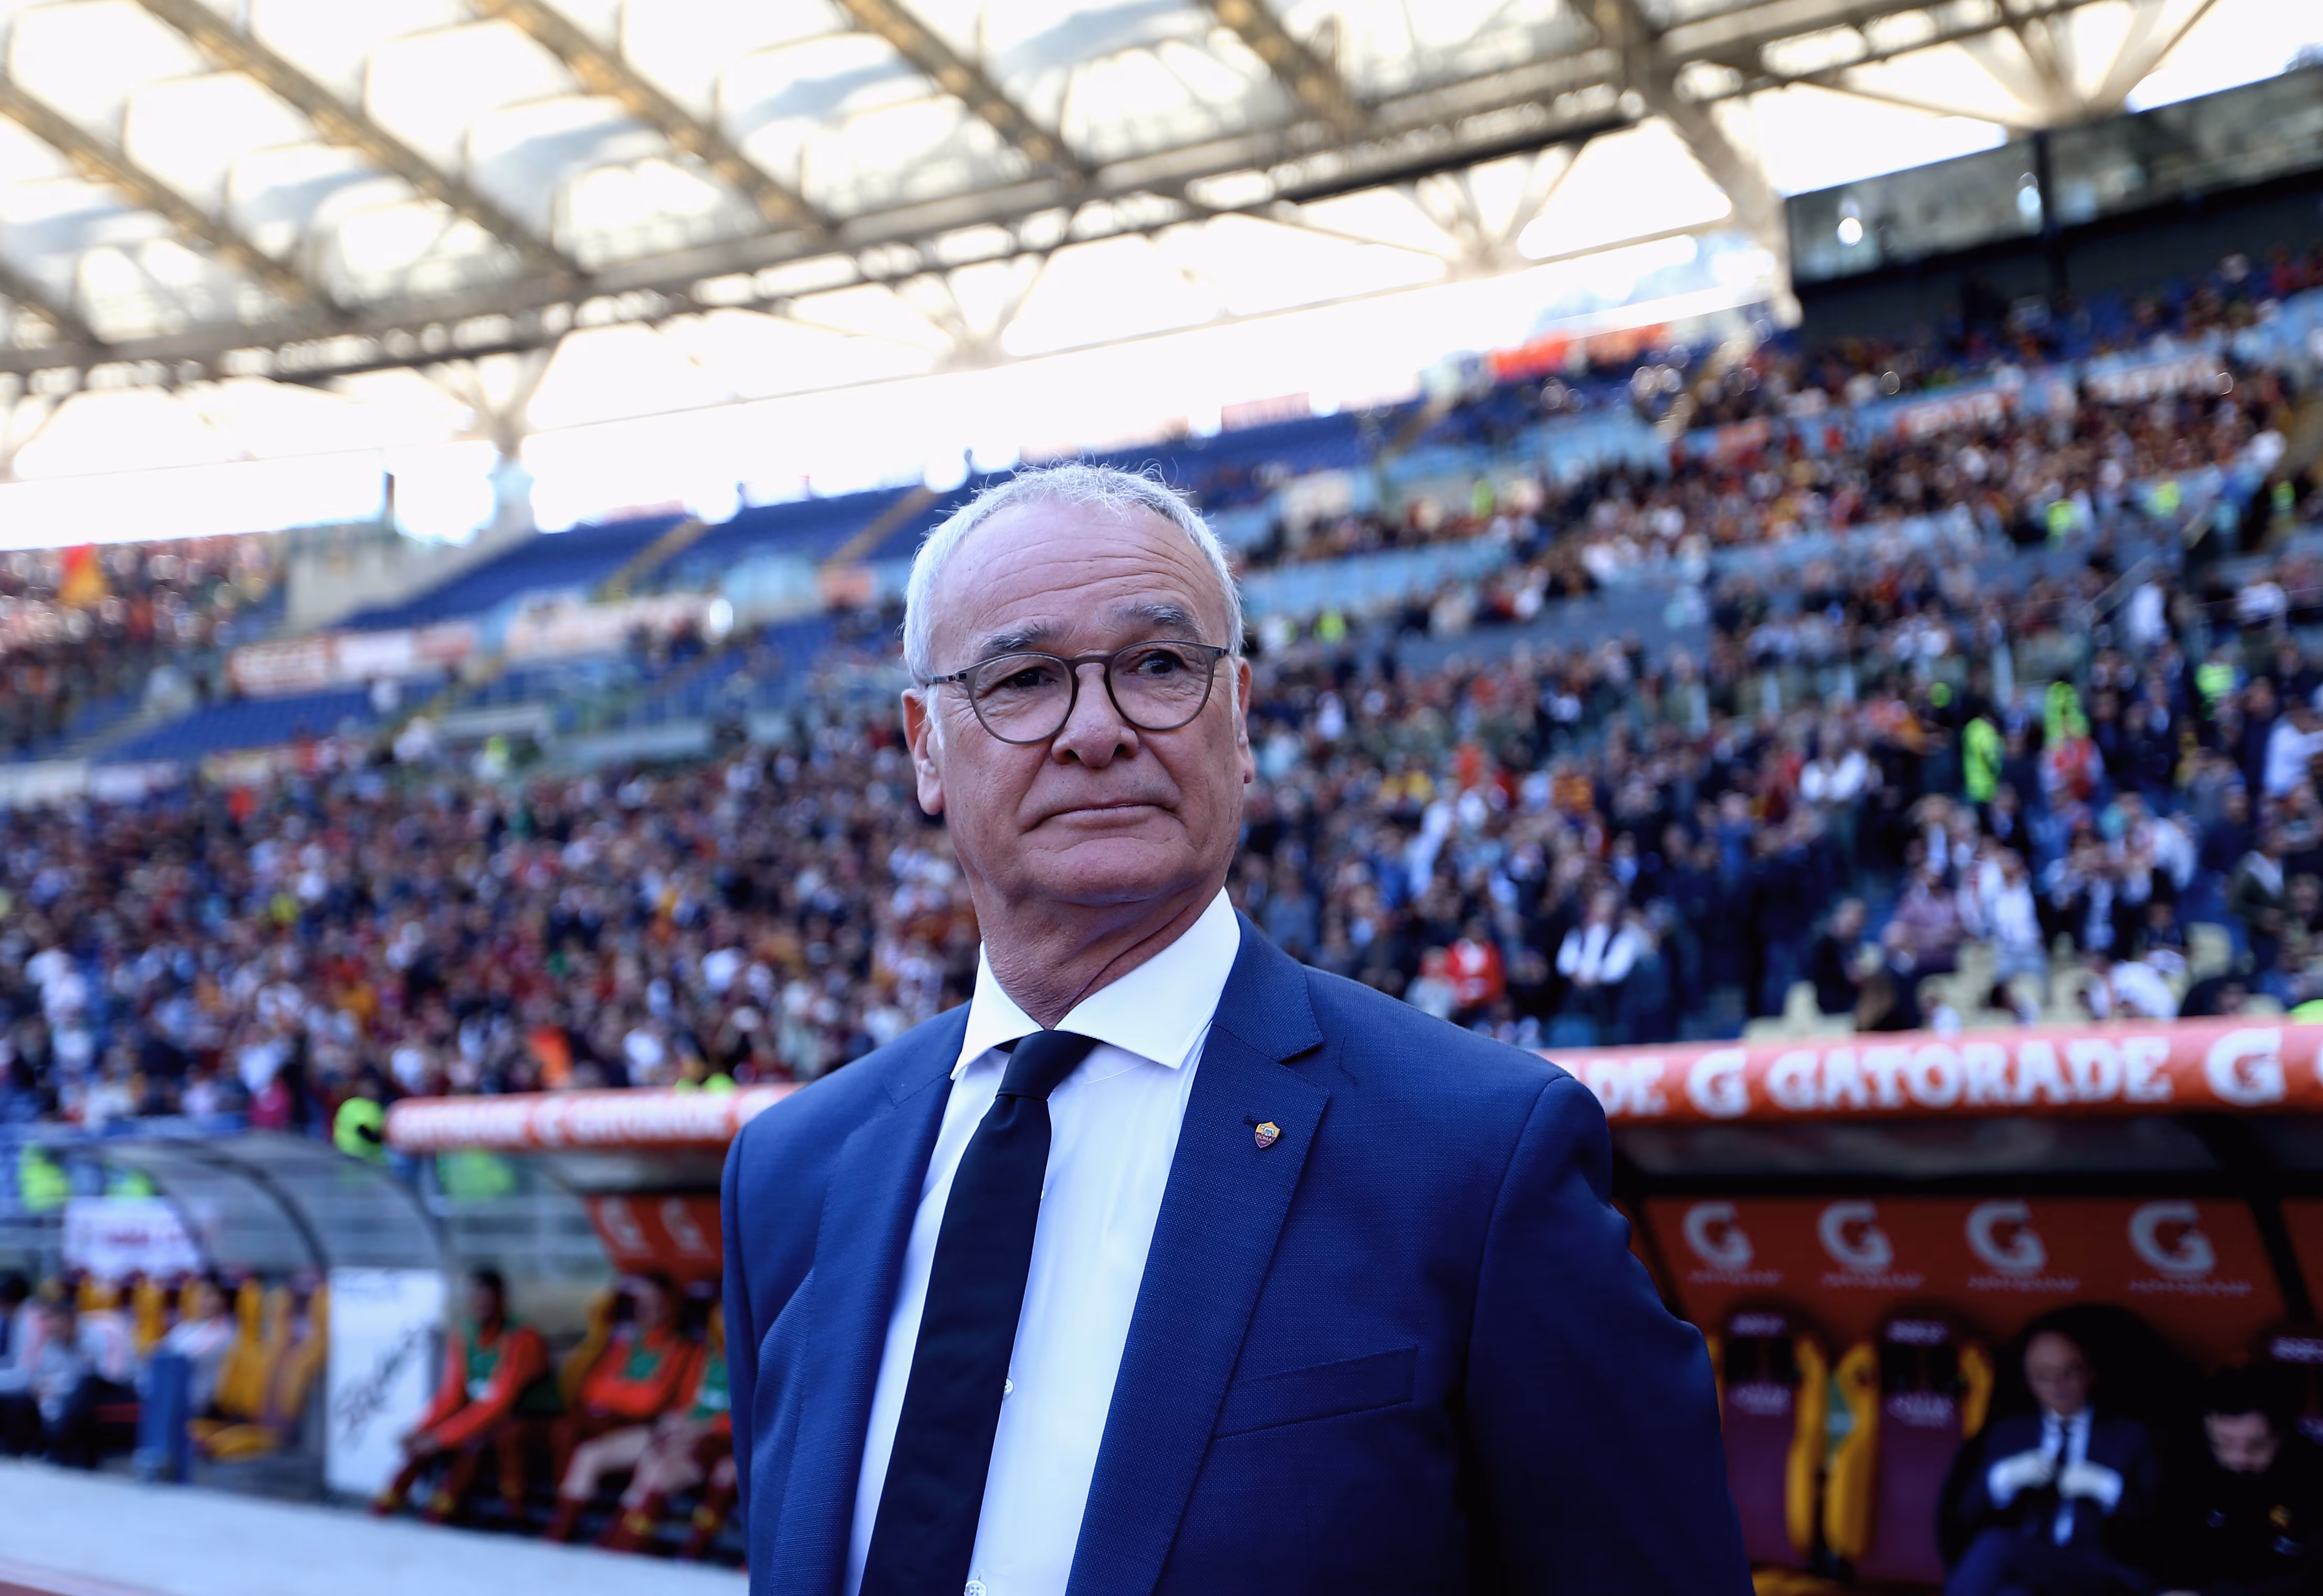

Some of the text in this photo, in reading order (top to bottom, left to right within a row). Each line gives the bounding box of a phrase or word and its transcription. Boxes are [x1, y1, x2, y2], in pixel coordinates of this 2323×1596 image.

[1562, 1056, 1668, 1117] DE
[1687, 1048, 1750, 1119] G
[1766, 1037, 2173, 1111] GATORADE
[2207, 1027, 2288, 1107] G
[1682, 1200, 1754, 1273] G
[1818, 1200, 1893, 1273] G
[1966, 1200, 2046, 1275] G
[2128, 1200, 2216, 1276] G
